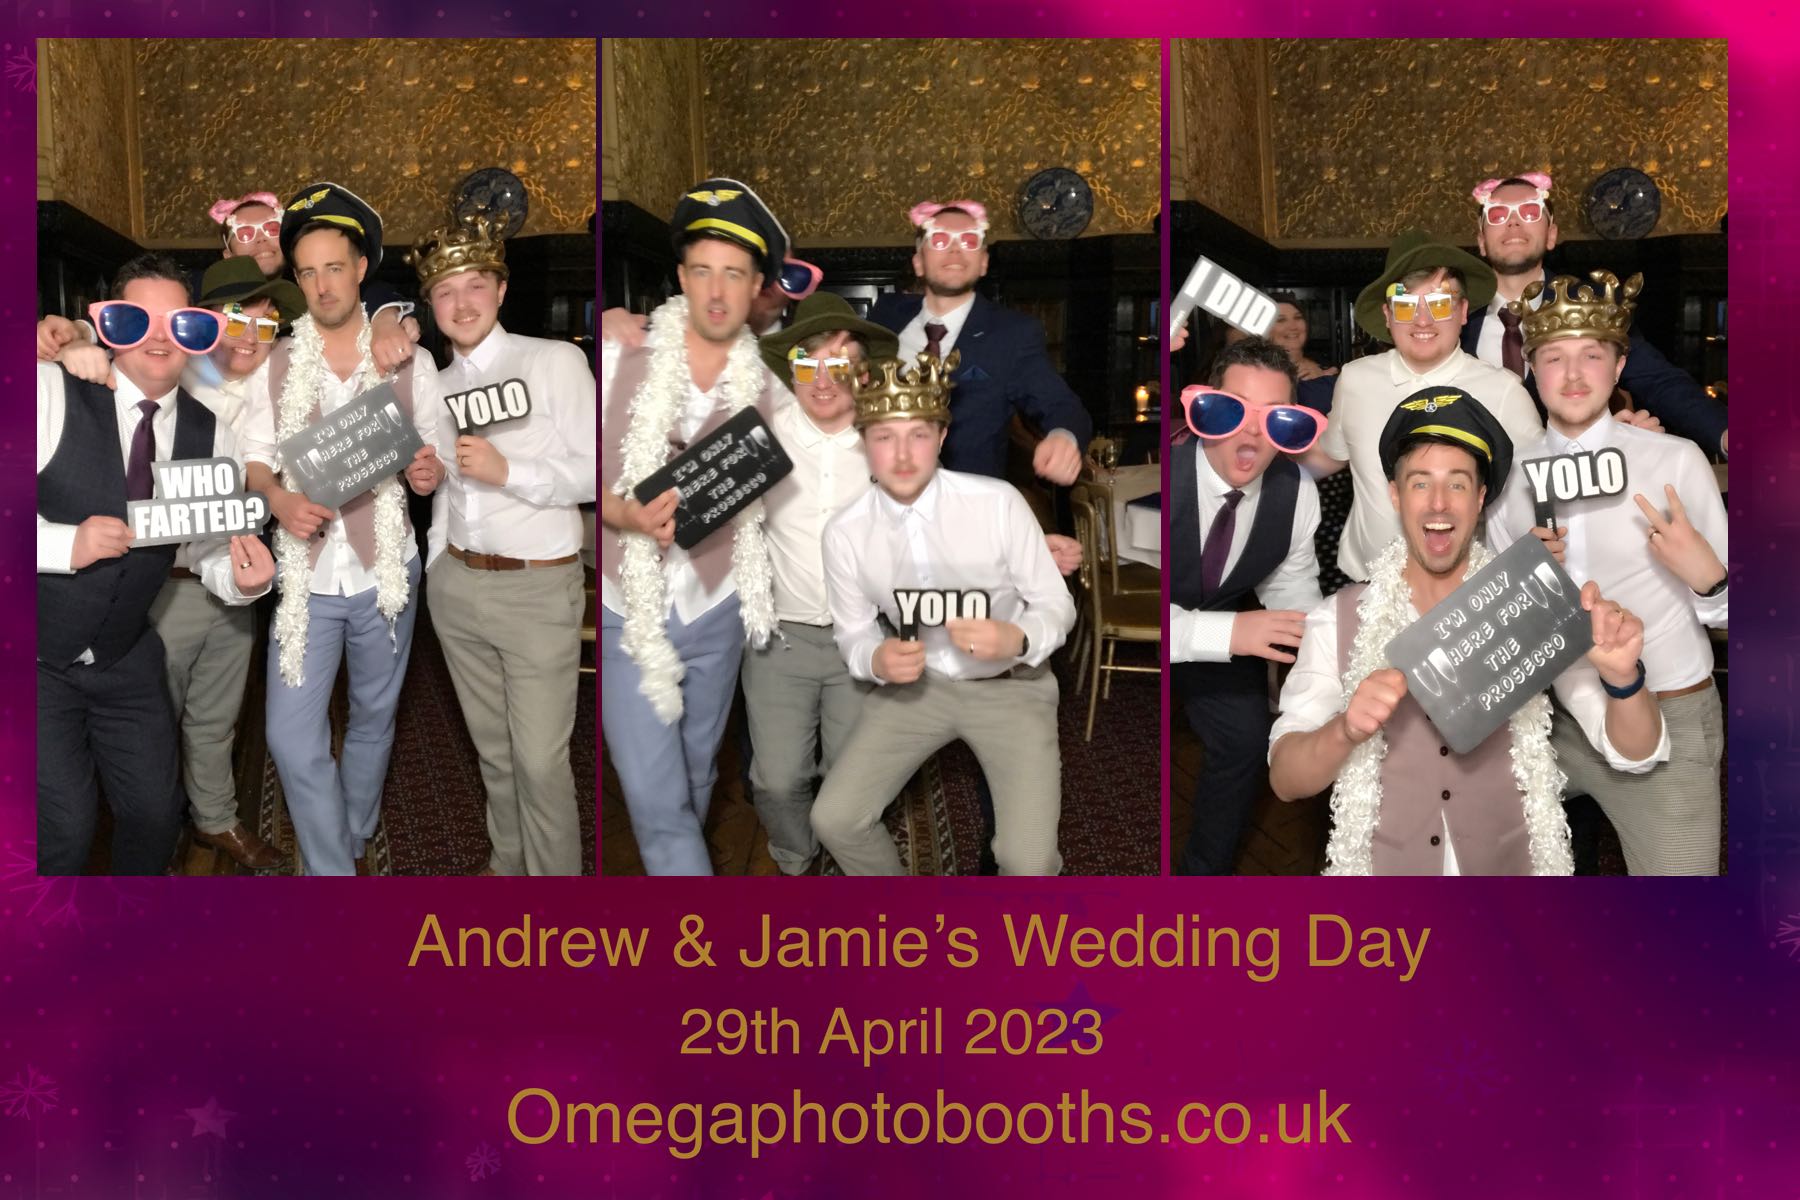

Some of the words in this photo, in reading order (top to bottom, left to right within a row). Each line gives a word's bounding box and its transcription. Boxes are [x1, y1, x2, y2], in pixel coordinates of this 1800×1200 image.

[1184, 260, 1212, 298] I
[1204, 273, 1276, 336] DID
[313, 425, 336, 444] I'M
[339, 405, 367, 430] ONLY
[447, 381, 528, 429] YOLO
[321, 436, 353, 462] HERE
[357, 420, 380, 441] FOR
[344, 448, 369, 469] THE
[672, 460, 699, 481] I'M
[700, 433, 732, 462] ONLY
[160, 463, 234, 499] WHO
[338, 449, 398, 492] PROSECCO
[681, 468, 718, 498] HERE
[708, 477, 736, 499] THE
[1525, 451, 1624, 503] YOLO
[135, 497, 264, 539] FARTED?
[701, 472, 766, 524] PROSECCO
[1434, 608, 1466, 640] I'M
[1469, 571, 1510, 611] ONLY
[1447, 622, 1494, 666] HERE
[1496, 592, 1532, 625] FOR
[1479, 633, 1565, 710] PROSECCO
[1484, 638, 1520, 671] THE
